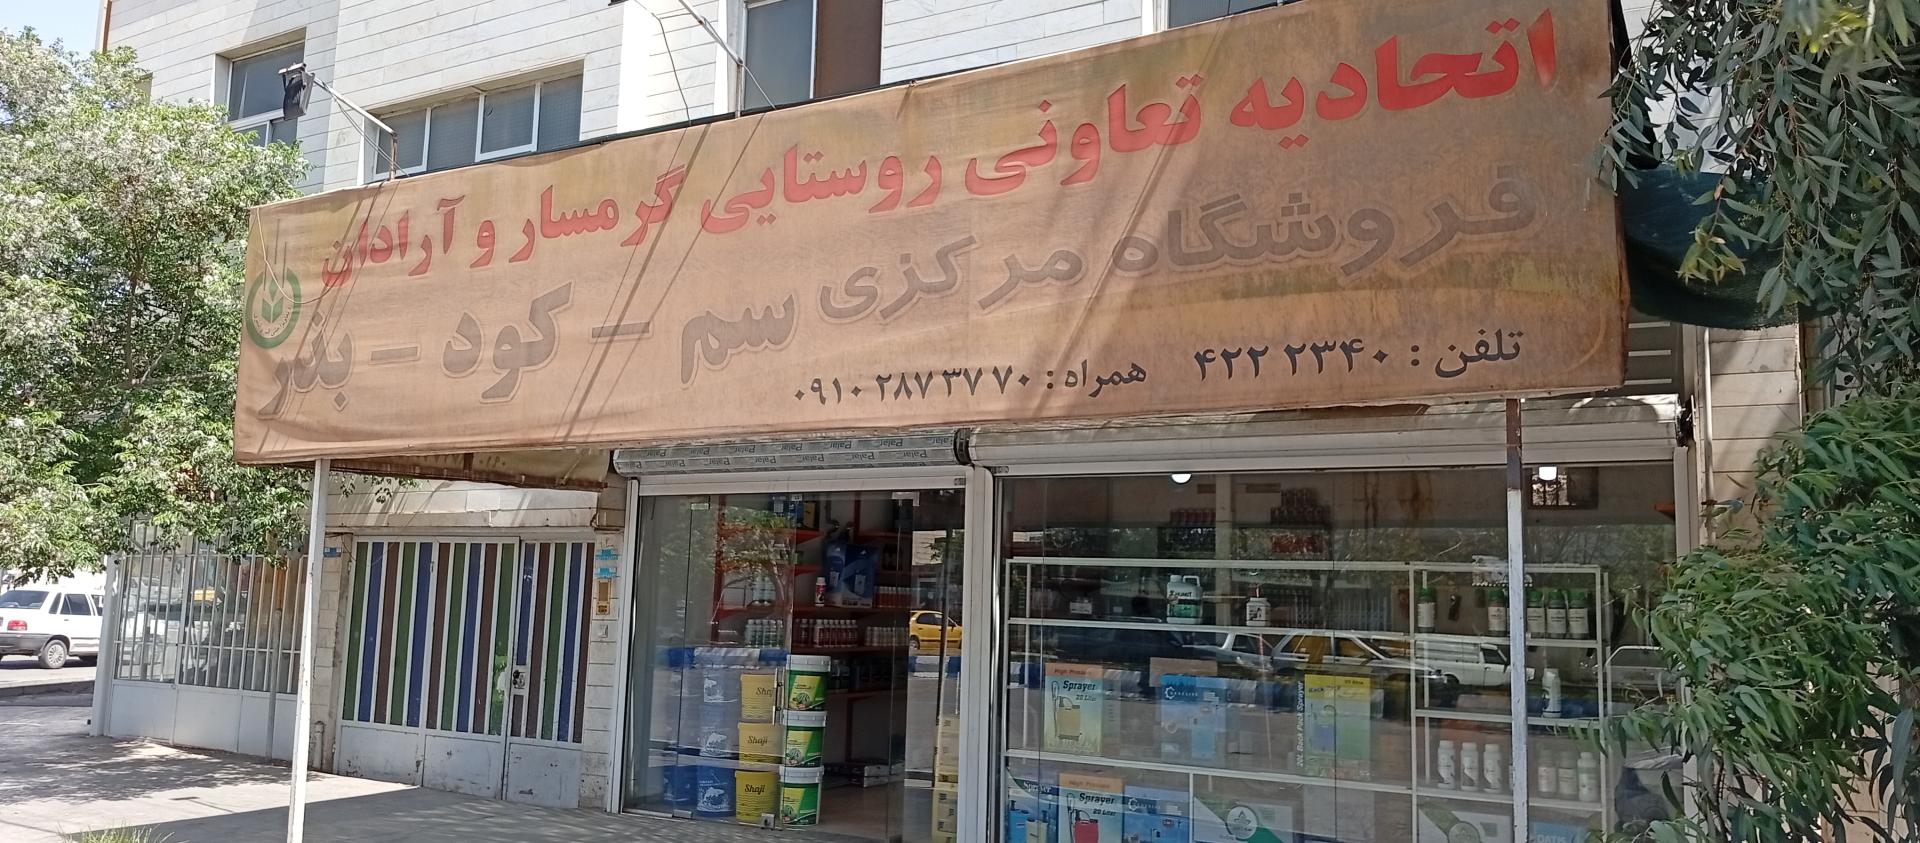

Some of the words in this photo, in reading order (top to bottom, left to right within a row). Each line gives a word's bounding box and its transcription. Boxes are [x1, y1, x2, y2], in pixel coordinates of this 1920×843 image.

[1230, 8, 1556, 150] اتحادیه
[965, 74, 1203, 196] تعاونی
[509, 164, 686, 264] گرمسار
[700, 143, 943, 235] روستایی
[1112, 164, 1541, 277] فروشگاه
[322, 194, 465, 288] آرادان
[470, 218, 496, 268] و
[820, 234, 1084, 320] مرکزی
[257, 310, 353, 417] بذر
[442, 281, 573, 400] کود
[681, 294, 795, 386] سم
[1062, 680, 1097, 692] Sprayer
[744, 784, 766, 796] Shaji
[1079, 792, 1115, 806] Sprayer
